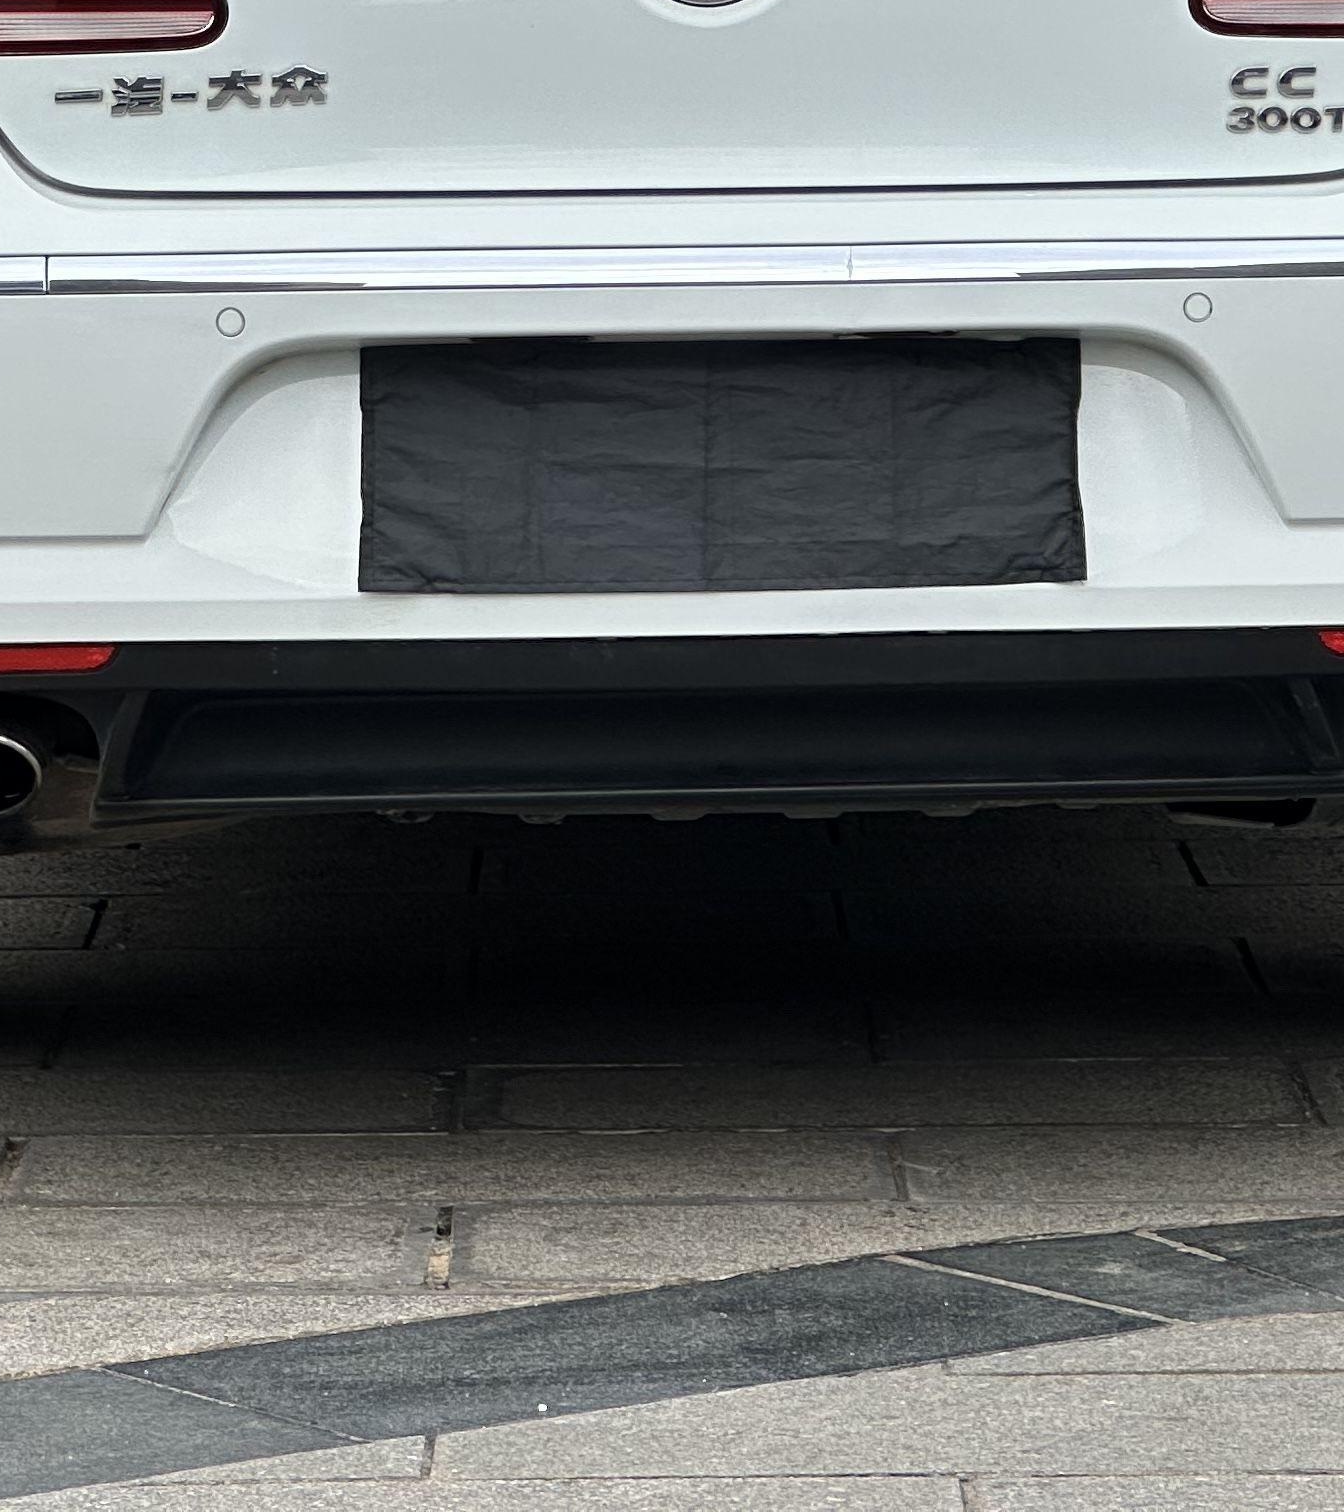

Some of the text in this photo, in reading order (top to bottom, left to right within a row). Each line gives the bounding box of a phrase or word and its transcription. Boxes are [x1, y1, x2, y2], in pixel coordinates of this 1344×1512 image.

[55, 65, 329, 116] 一汽-大众
[1229, 65, 1317, 99] CC
